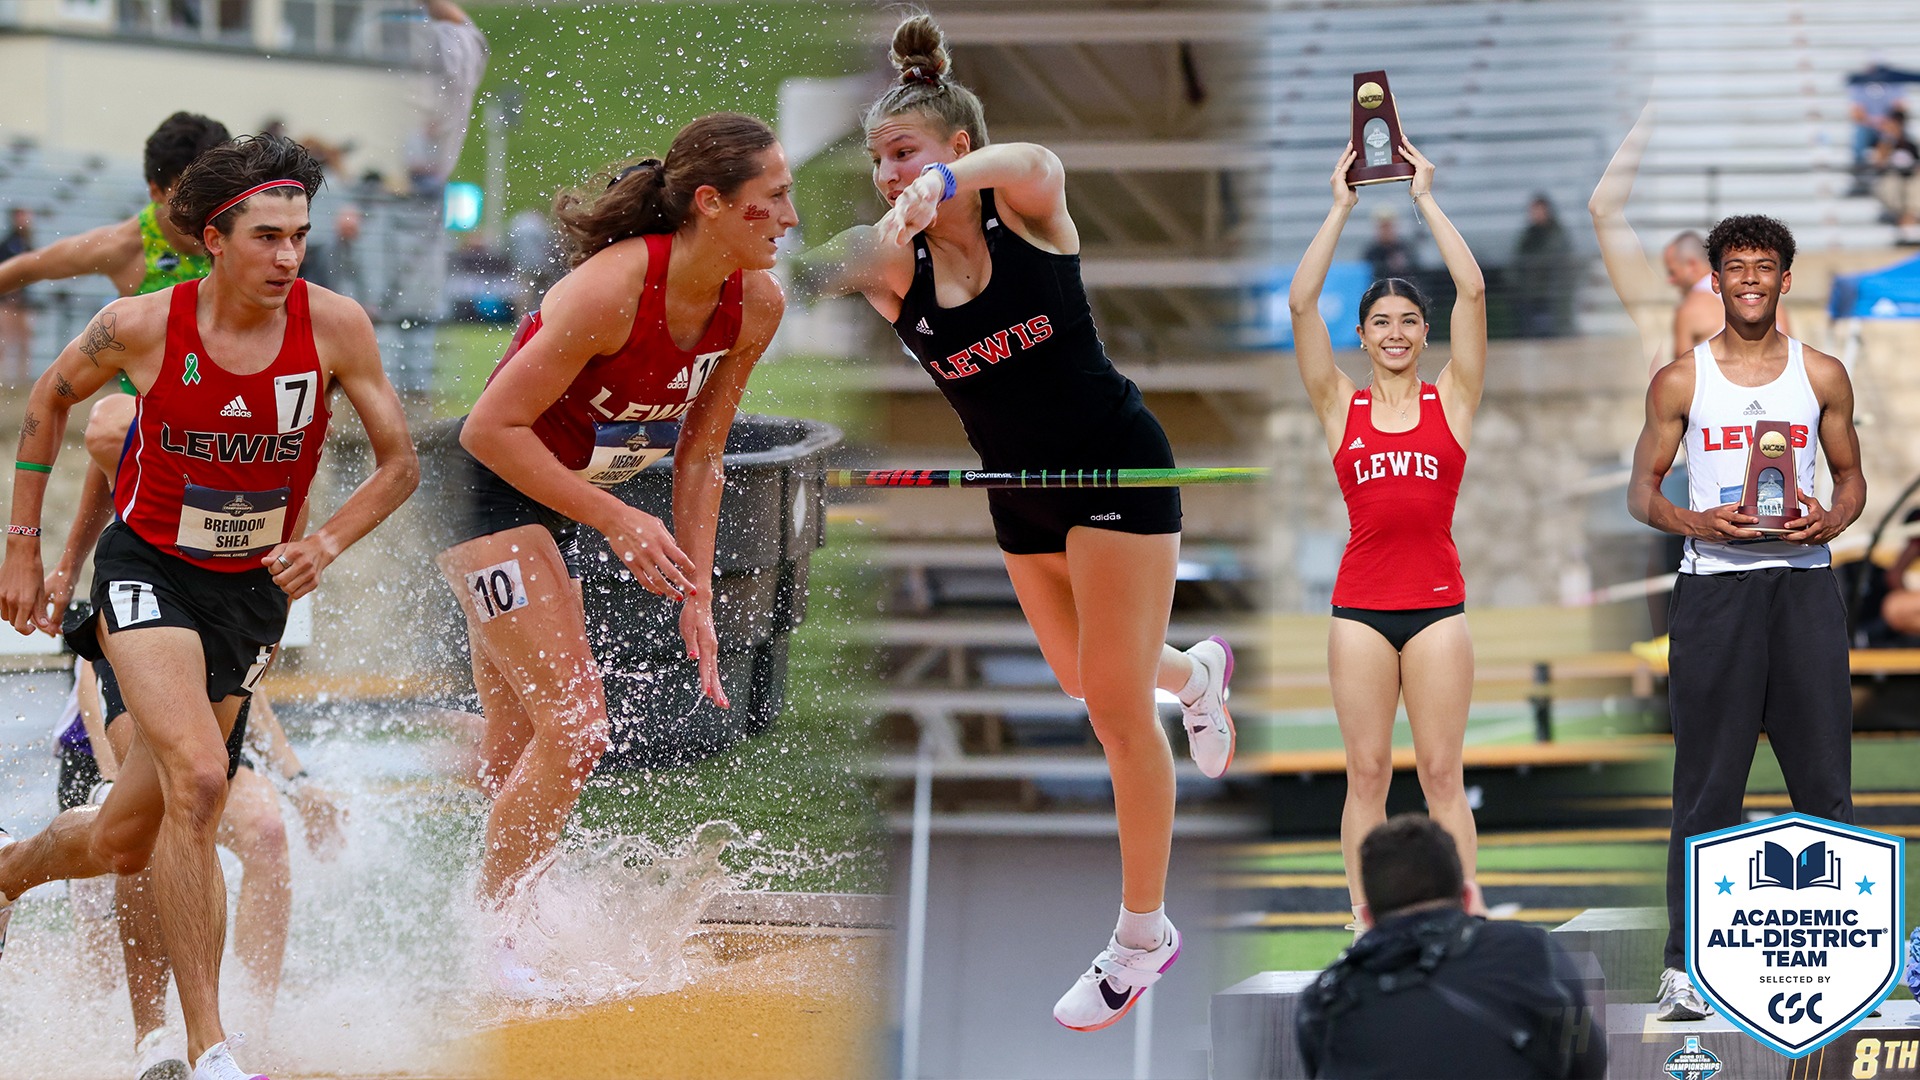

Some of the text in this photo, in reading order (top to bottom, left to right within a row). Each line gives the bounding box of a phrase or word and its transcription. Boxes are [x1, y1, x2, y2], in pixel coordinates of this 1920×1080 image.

[930, 315, 1054, 380] LEWIS
[285, 379, 308, 430] 7
[589, 386, 697, 422] LEWI
[1743, 408, 1767, 416] adidas
[220, 408, 252, 418] adidas
[161, 422, 305, 463] LEWIS
[1701, 424, 1809, 452] LES
[1761, 444, 1785, 452] NCAA
[608, 455, 646, 469] MEGAN
[1353, 451, 1439, 485] LEWIS
[590, 469, 639, 481] GARRETT
[865, 469, 934, 486] GILL
[1090, 512, 1122, 521] adidas
[203, 517, 266, 533] BRENDON
[215, 534, 250, 548] SHEA
[474, 569, 514, 617] 10
[118, 584, 142, 621] 7
[1665, 1062, 1721, 1071] CHAMPIONSHIPS
